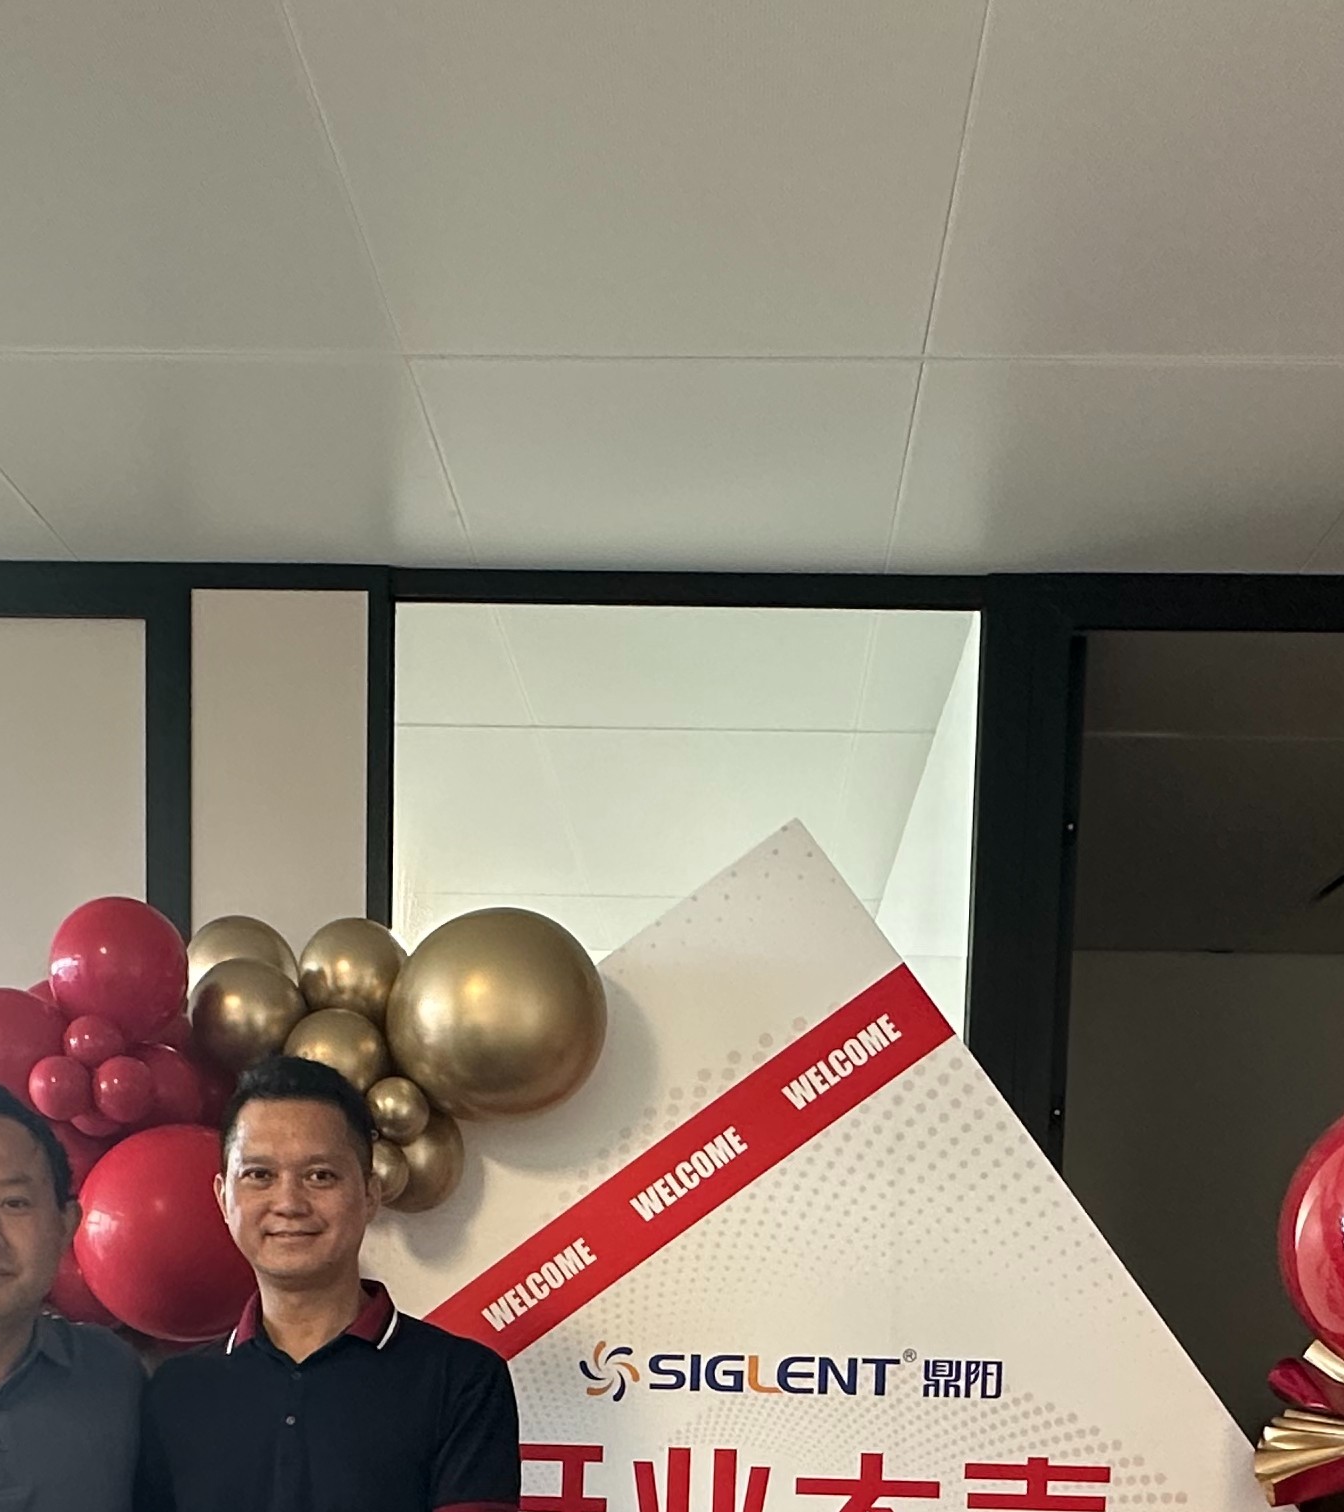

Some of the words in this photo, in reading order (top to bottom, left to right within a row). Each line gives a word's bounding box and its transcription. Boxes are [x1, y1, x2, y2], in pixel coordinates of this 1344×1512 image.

[481, 1237, 597, 1332] WELCOME
[628, 1126, 748, 1223] WELCOME
[781, 1013, 902, 1111] WELCOME
[922, 1359, 1004, 1399] 鼎阳
